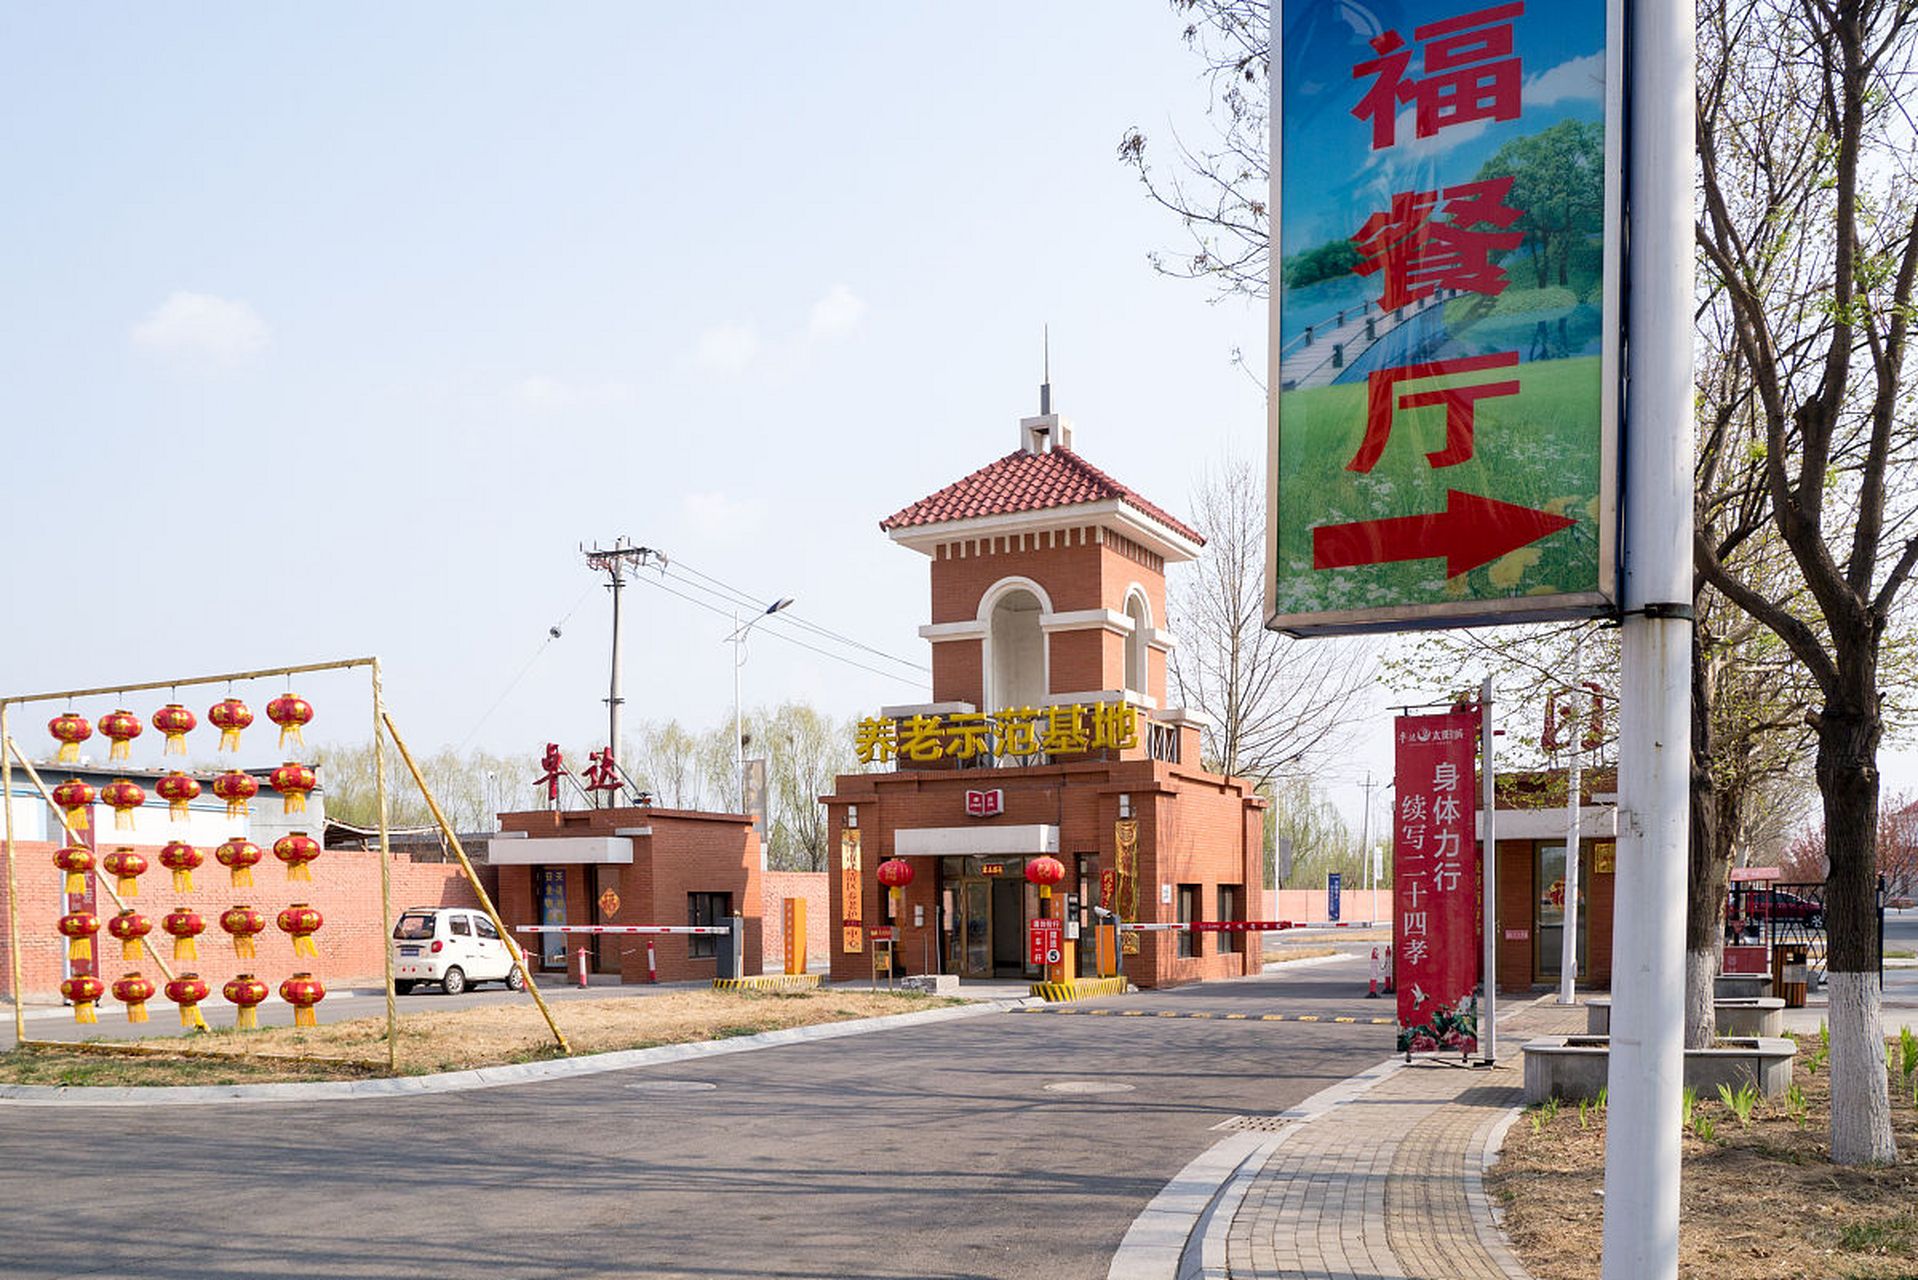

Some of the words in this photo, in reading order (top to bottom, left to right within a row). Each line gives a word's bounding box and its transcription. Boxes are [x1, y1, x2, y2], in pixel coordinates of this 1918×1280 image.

[1345, 2, 1526, 473] 福餐厅
[532, 743, 624, 801] 卓达
[855, 700, 1139, 763] 养老示范基地
[1402, 795, 1428, 965] 续写二十四孝
[1433, 762, 1461, 892] 身体力行
